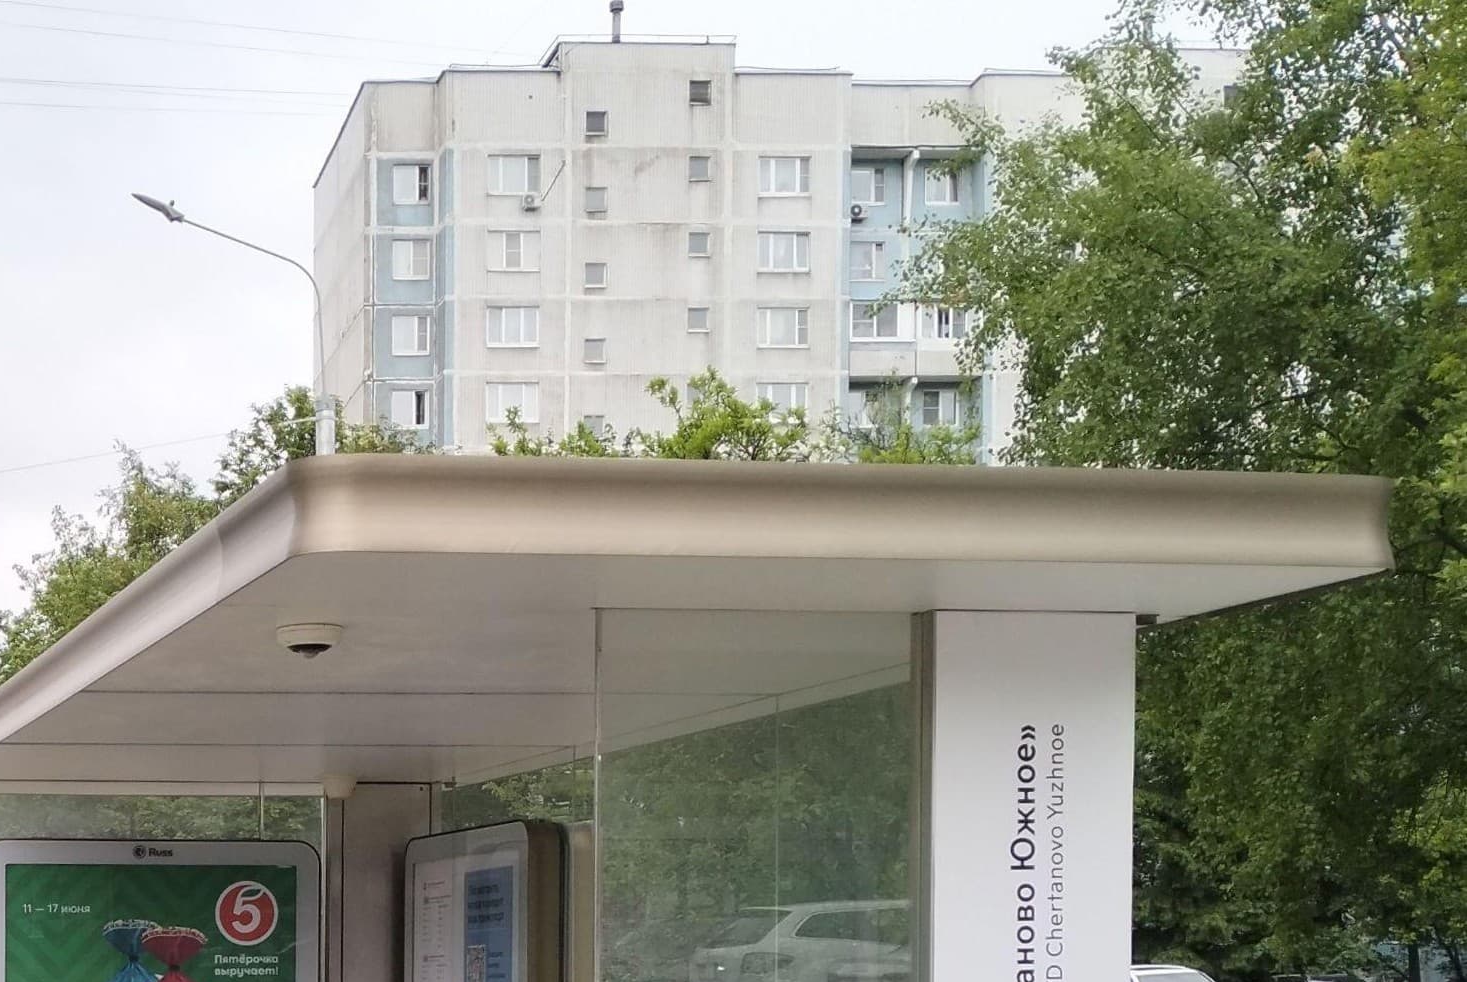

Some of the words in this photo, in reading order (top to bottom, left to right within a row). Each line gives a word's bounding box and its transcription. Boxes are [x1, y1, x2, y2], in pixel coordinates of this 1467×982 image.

[1047, 723, 1065, 821] Yuzhnoe
[1010, 724, 1036, 871] Южное»
[148, 847, 173, 857] Russ
[1046, 825, 1064, 957] Chertanovo
[22, 904, 32, 913] 11
[47, 903, 58, 913] 17
[60, 905, 91, 914] июня
[215, 954, 279, 966] Пятёрочка
[214, 967, 279, 979] выручает!
